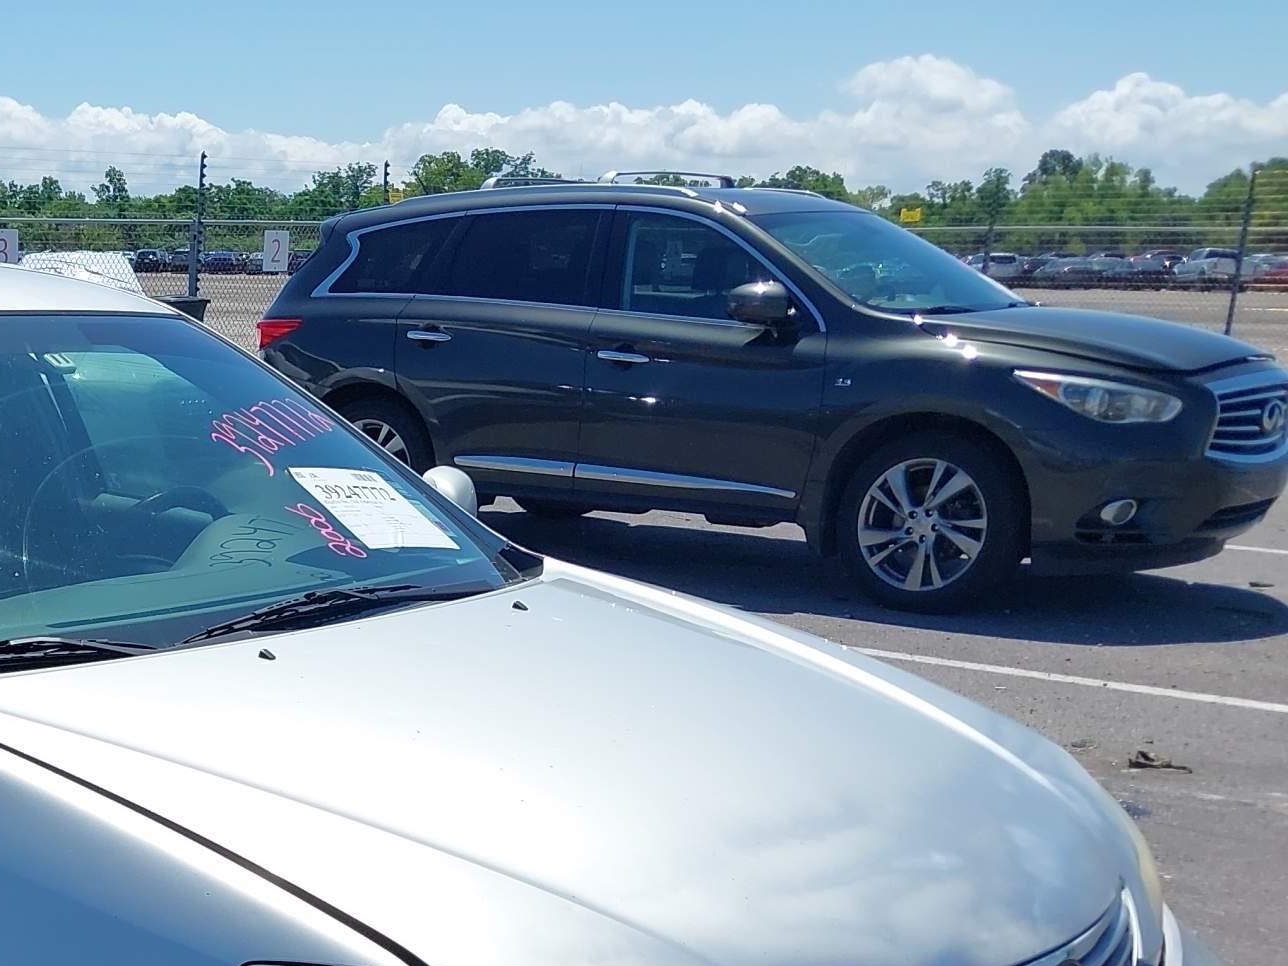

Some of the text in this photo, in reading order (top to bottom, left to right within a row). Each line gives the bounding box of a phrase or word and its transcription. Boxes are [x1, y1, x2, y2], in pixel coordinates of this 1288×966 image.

[271, 239, 281, 263] 2
[211, 398, 334, 477] 39247772
[314, 484, 397, 501] 39247772
